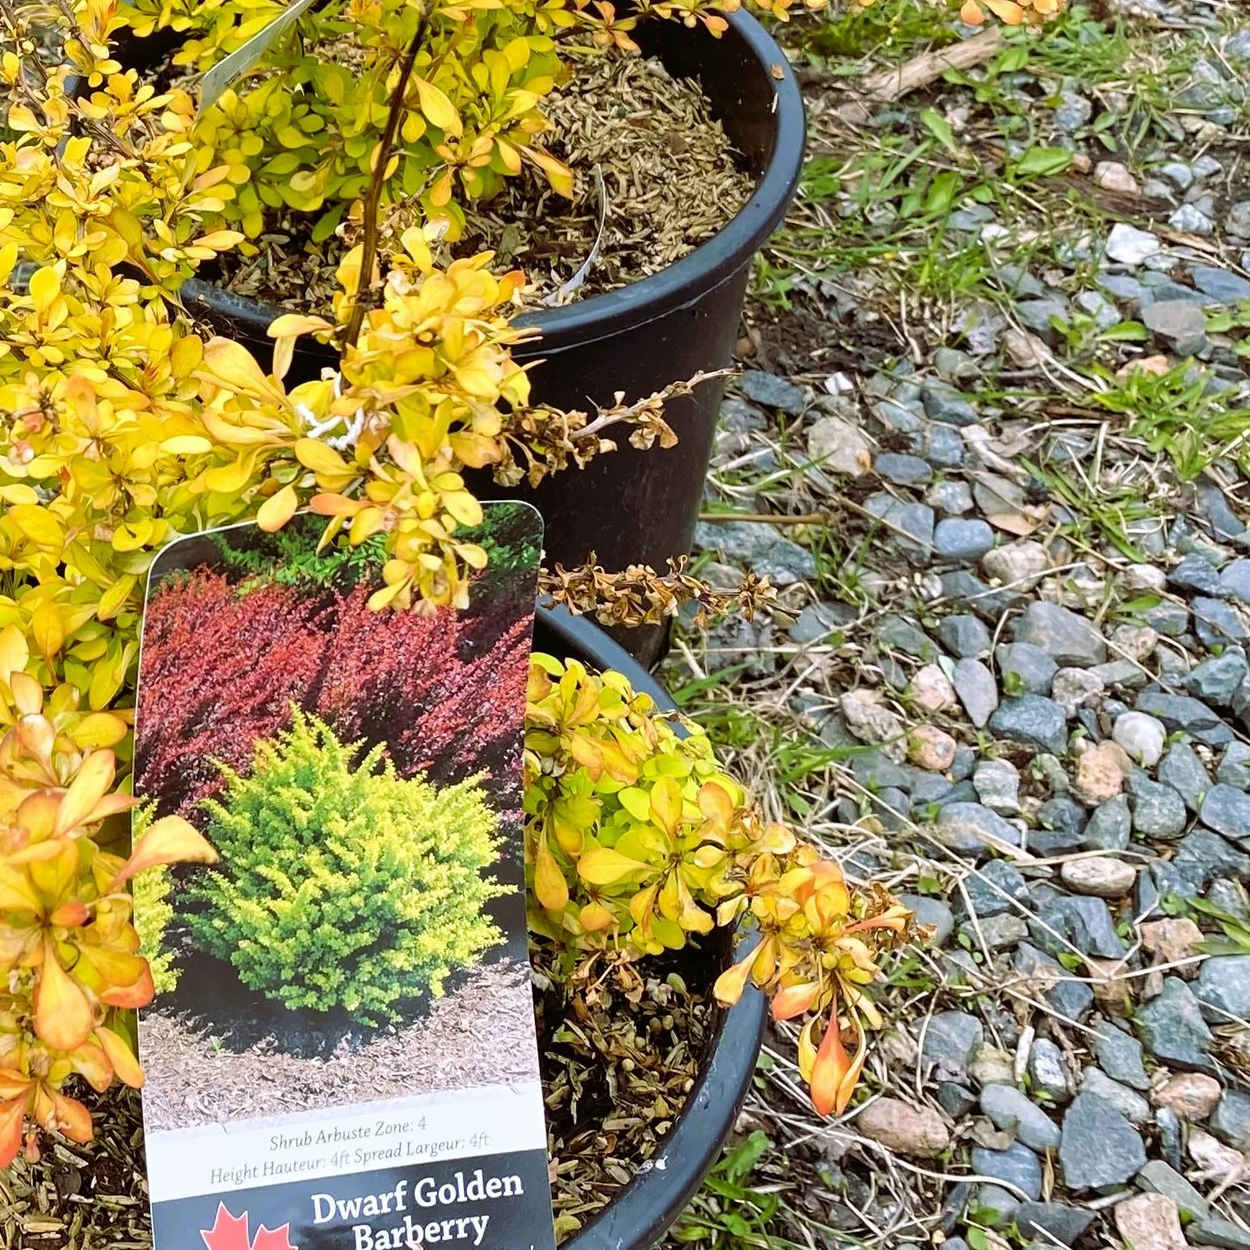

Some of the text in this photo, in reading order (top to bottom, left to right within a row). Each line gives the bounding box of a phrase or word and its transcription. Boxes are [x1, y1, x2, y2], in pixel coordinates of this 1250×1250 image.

[269, 1116, 427, 1151] Shrub Arbuste Zone: 4
[210, 1131, 490, 1185] Height Hauteur: 4ft Spread Largeur: 4ft
[311, 1169, 524, 1224] Dwarf Golden
[352, 1215, 490, 1250] Barberry
